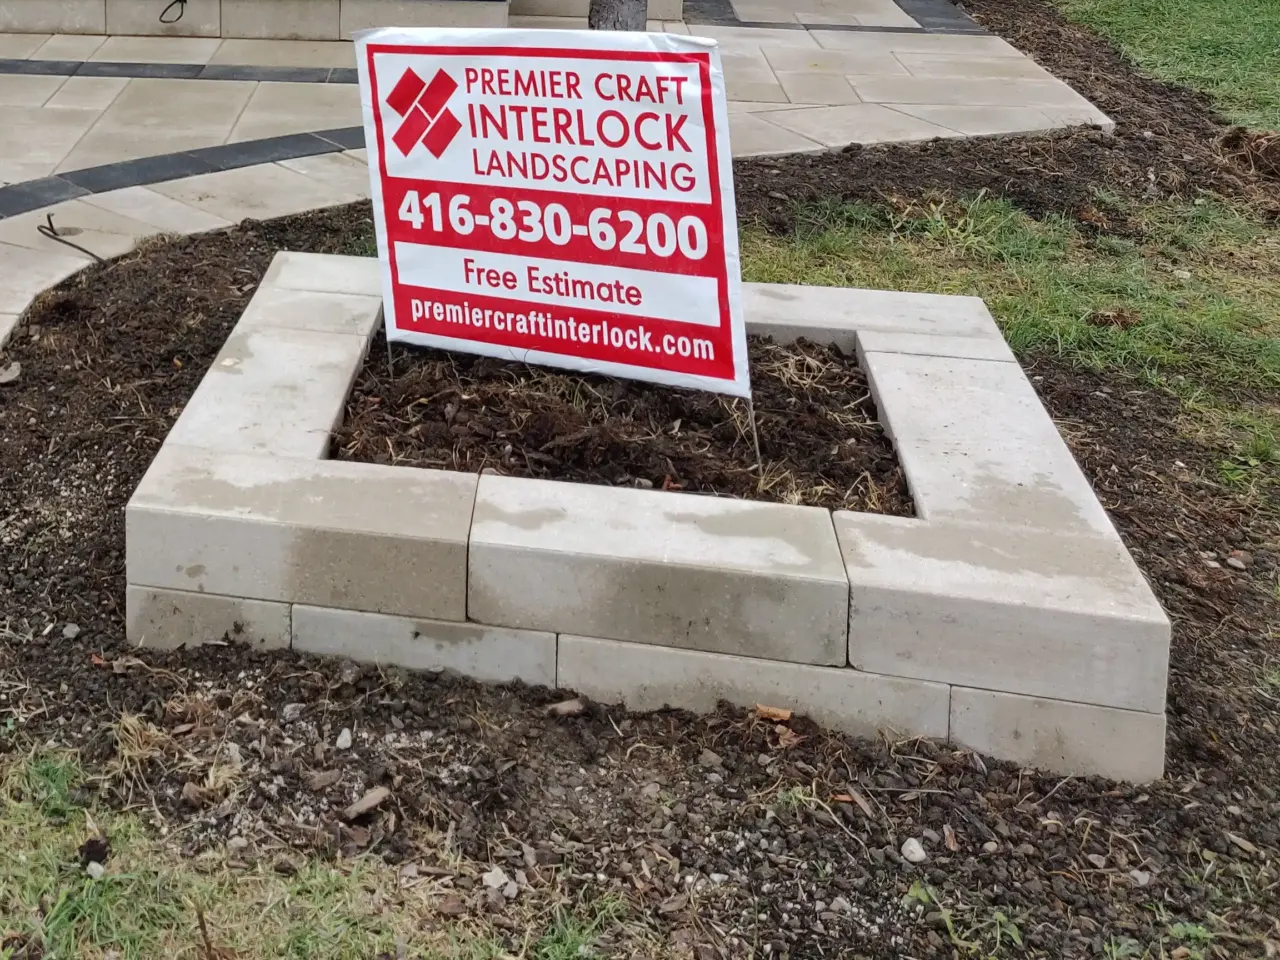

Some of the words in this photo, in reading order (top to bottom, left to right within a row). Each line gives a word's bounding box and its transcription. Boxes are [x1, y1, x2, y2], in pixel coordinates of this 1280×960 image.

[465, 67, 581, 99] PREMIER
[594, 72, 689, 105] CRAFT
[467, 103, 693, 153] INTERLOCK
[472, 148, 696, 192] LANDSCAPING
[398, 190, 708, 260] 416-830-6200
[463, 258, 518, 291] Free
[527, 266, 643, 307] Estimate
[411, 297, 715, 361] premiercraftinterlock.com
